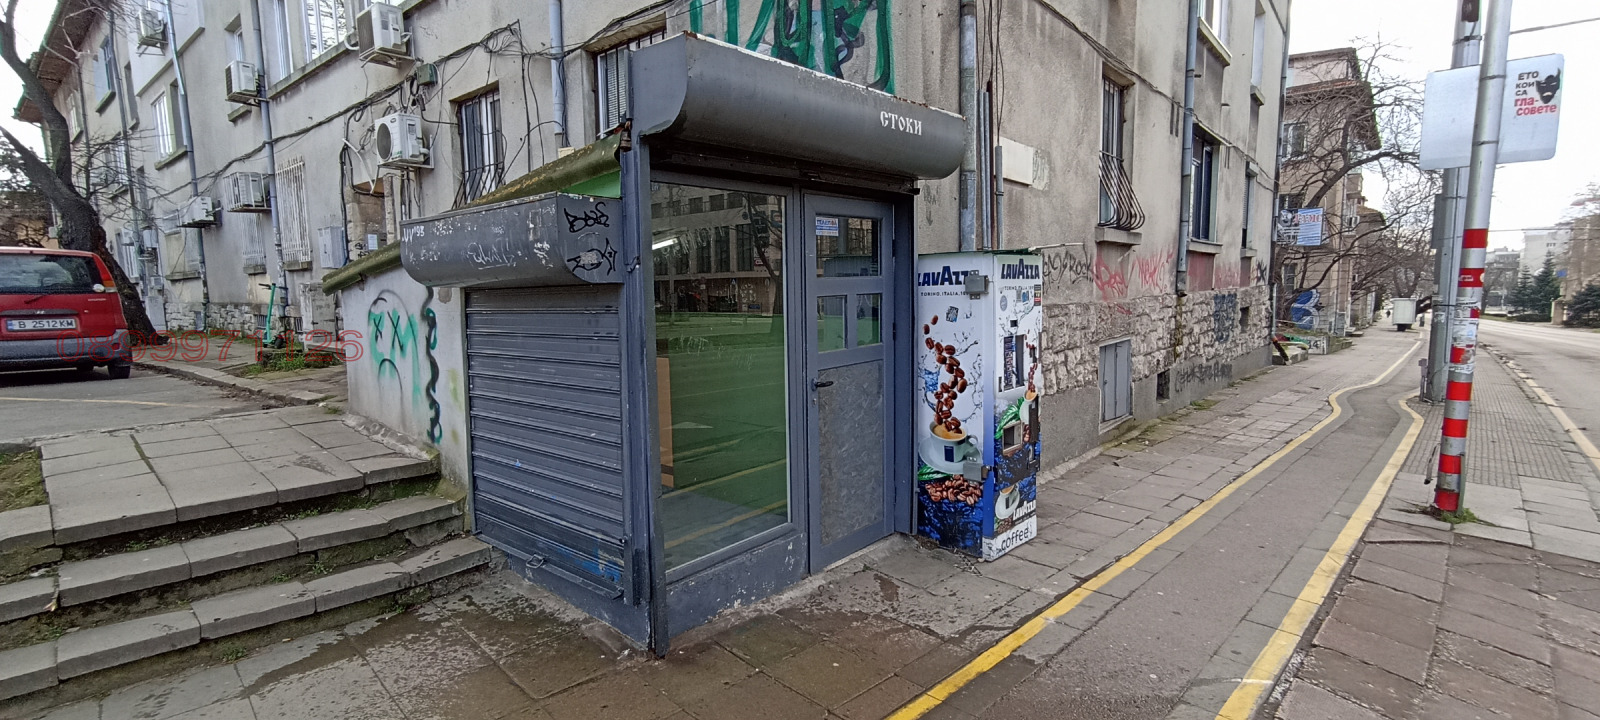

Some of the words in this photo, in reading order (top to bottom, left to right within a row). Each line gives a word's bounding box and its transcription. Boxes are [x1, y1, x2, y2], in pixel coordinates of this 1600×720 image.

[1518, 71, 1539, 81] ЕТО
[880, 110, 922, 136] СТОКИ
[917, 265, 969, 287] AVAZ
[1001, 258, 1040, 280] LAVAZZA
[1001, 526, 1029, 551] coffee
